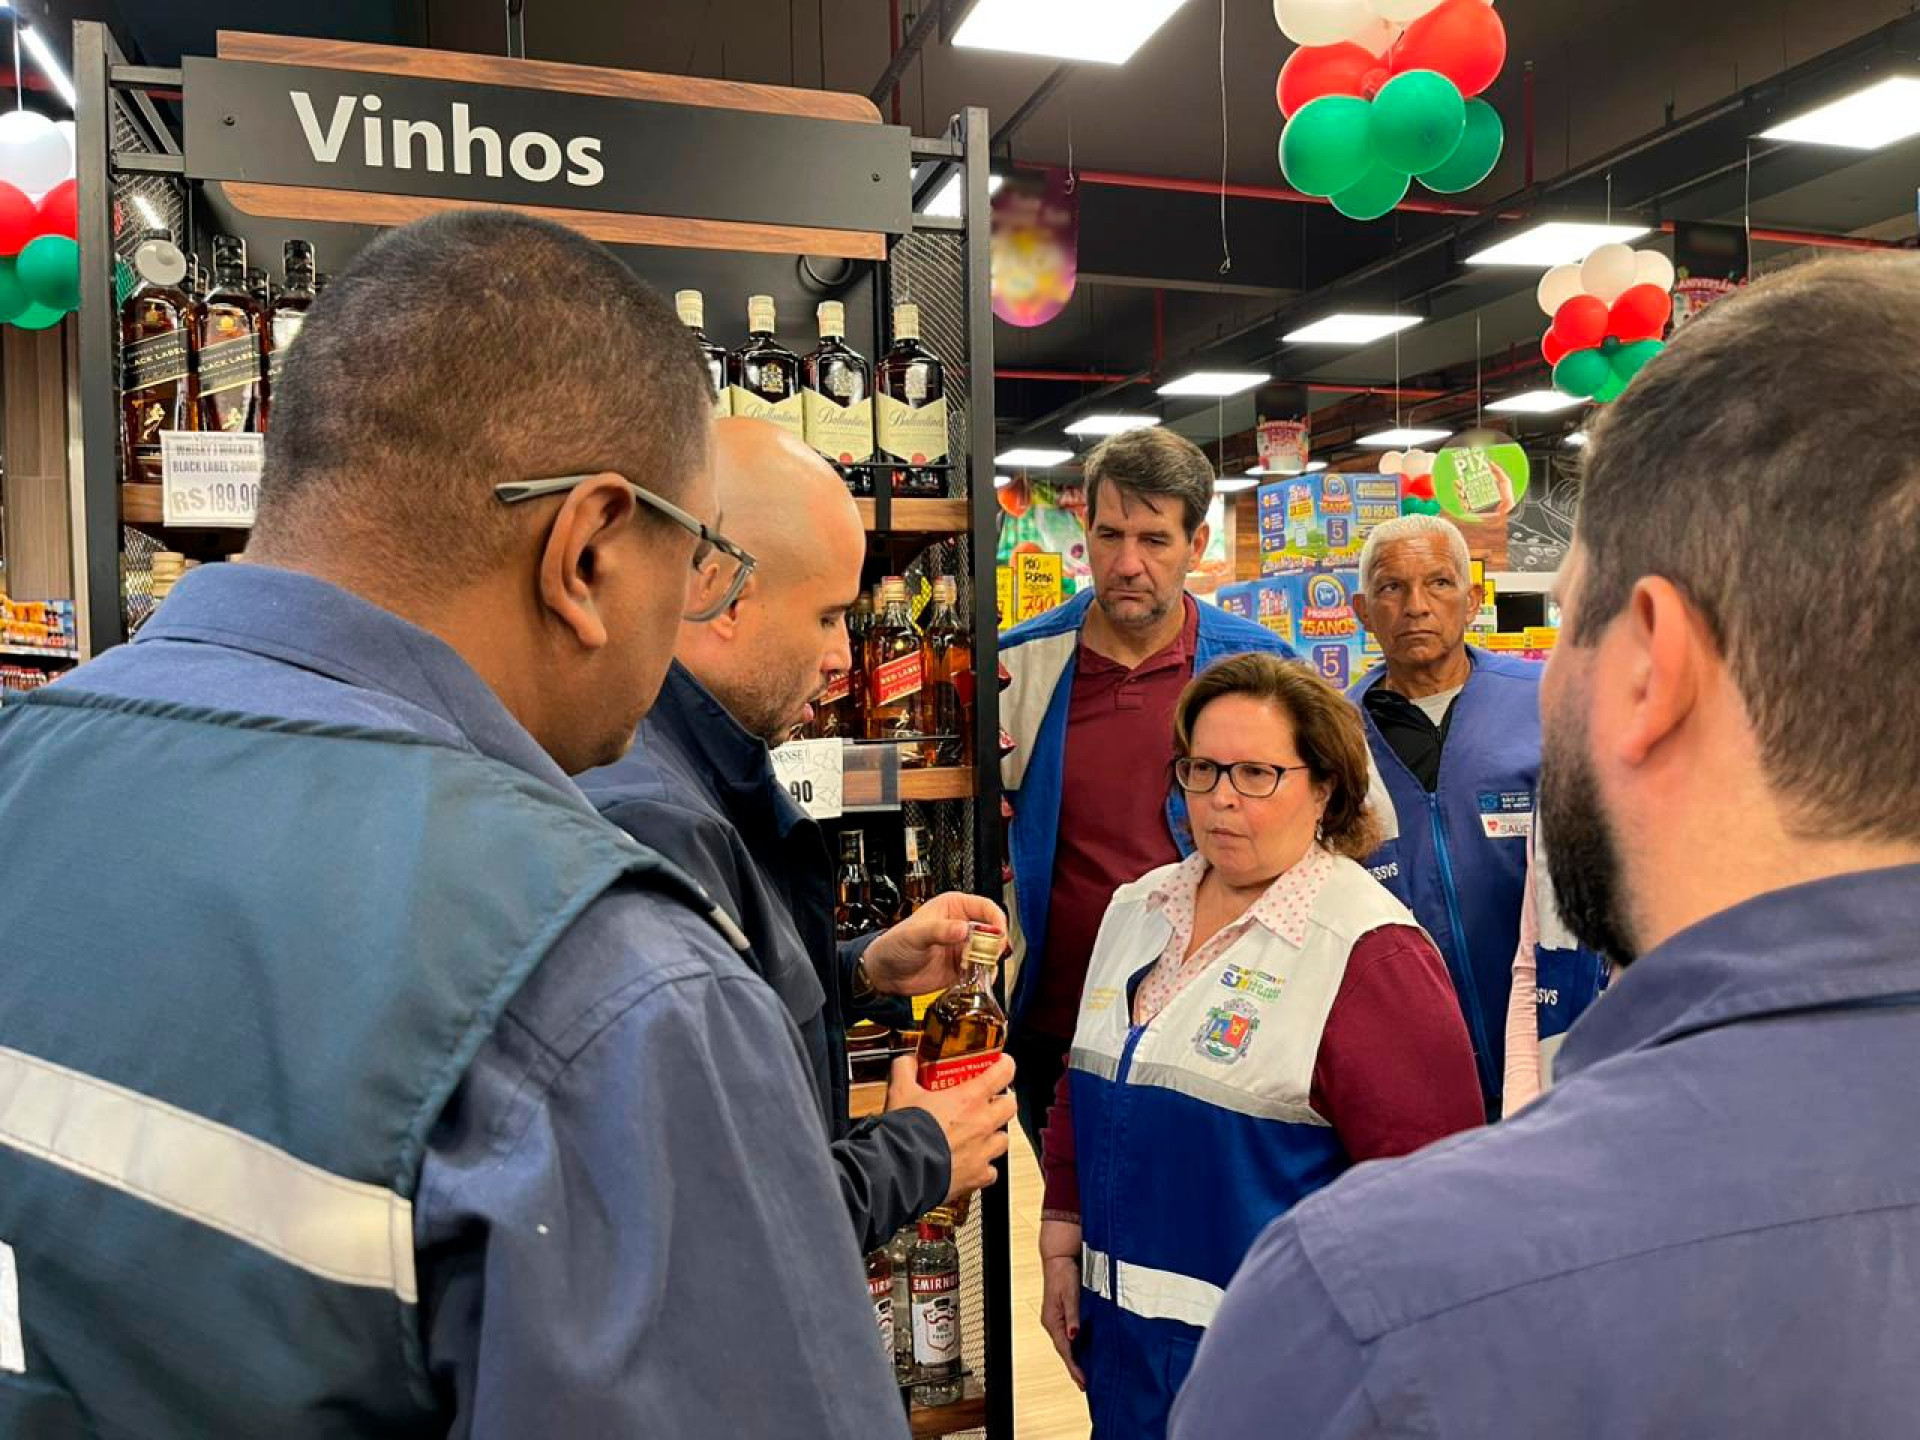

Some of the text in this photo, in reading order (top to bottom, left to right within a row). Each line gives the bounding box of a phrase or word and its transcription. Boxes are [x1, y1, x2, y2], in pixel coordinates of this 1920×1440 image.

[289, 90, 604, 186] Vinhos
[155, 347, 187, 360] LABEL
[198, 351, 260, 373] BLACK LABEL
[173, 460, 201, 472] BLACK
[204, 460, 228, 472] LABEL
[1455, 453, 1489, 476] PIX
[1332, 522, 1343, 538] 5
[1024, 572, 1054, 583] FORMA
[1322, 652, 1340, 678] 5
[937, 1064, 966, 1078] JOHNNIE
[931, 1077, 955, 1090] RED
